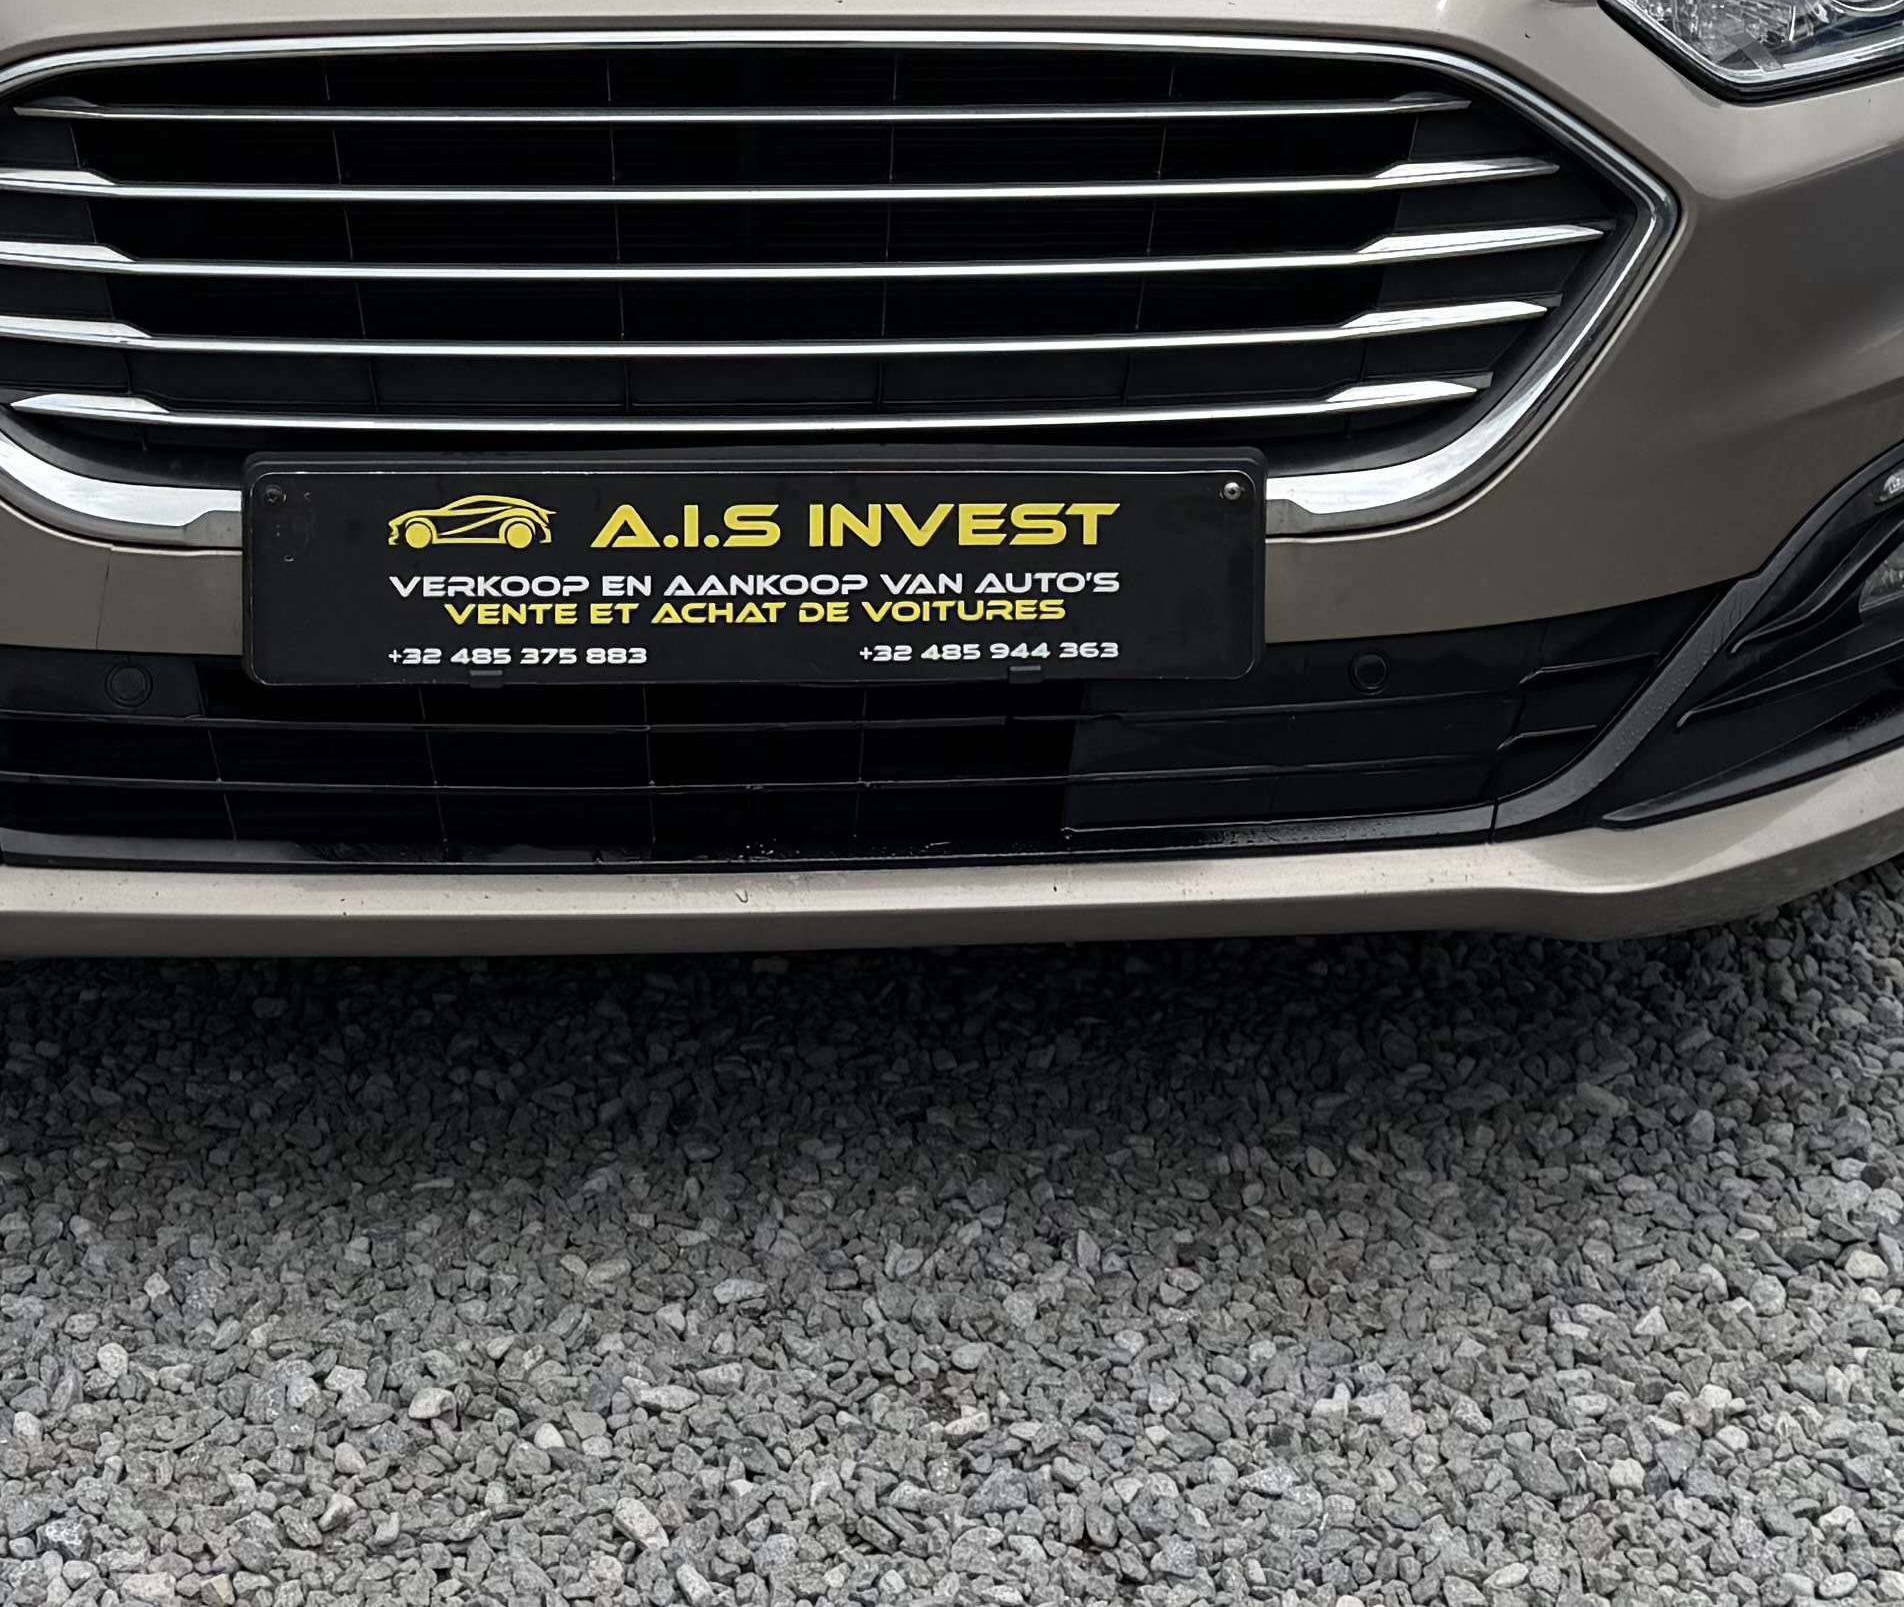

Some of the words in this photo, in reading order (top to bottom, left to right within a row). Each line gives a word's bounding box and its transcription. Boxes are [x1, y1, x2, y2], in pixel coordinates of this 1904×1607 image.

[590, 504, 781, 548] A.I.S
[809, 503, 1120, 547] INVEST
[389, 576, 589, 598] VERKOOP
[602, 575, 652, 597] EN
[664, 574, 868, 596] AANKOOP
[880, 573, 963, 595] VAN
[975, 572, 1120, 594] AUTO'S
[444, 603, 578, 625] VENTE
[590, 603, 639, 625] ET
[650, 602, 786, 624] ACHAT
[799, 601, 850, 623] DE
[862, 599, 1066, 623] VOITURES
[388, 648, 442, 665] +32
[450, 648, 512, 665] 485
[520, 648, 578, 665] 375
[586, 647, 647, 665] 883
[859, 645, 912, 663] +32
[921, 644, 981, 661] 485
[990, 643, 1051, 661] 944
[1059, 642, 1119, 659] 363
